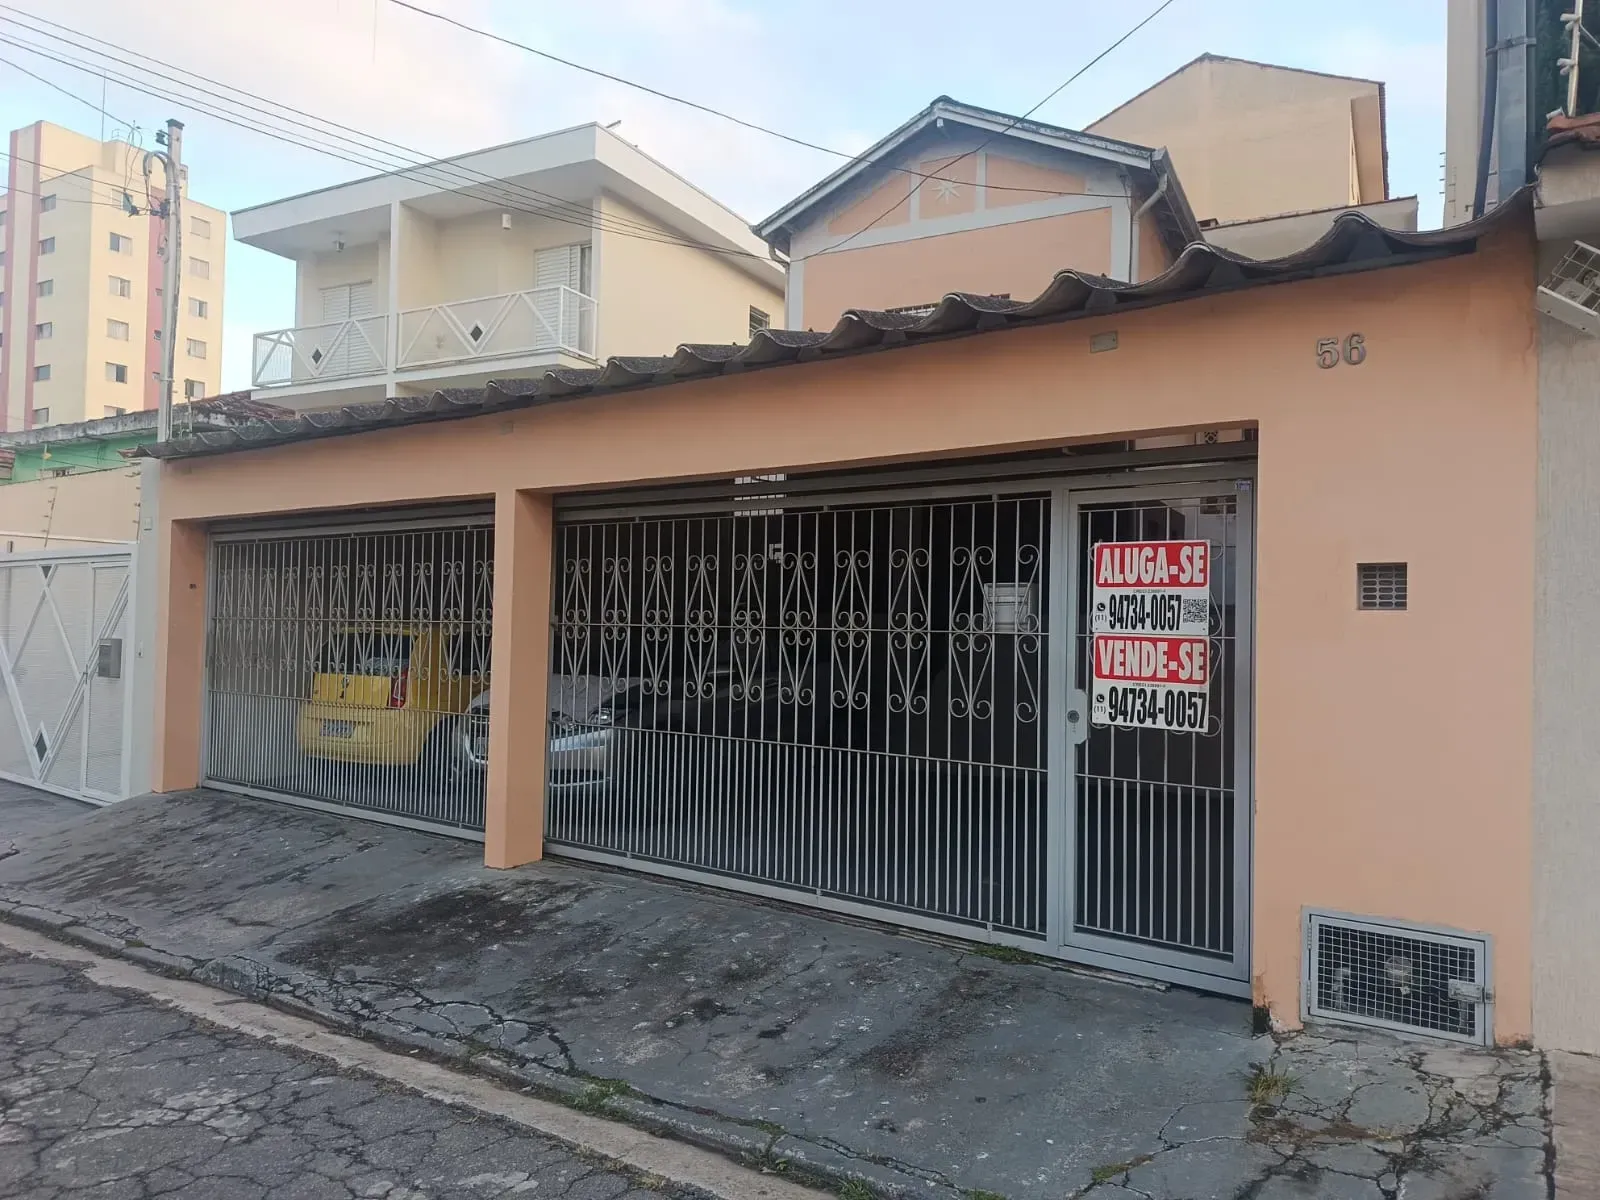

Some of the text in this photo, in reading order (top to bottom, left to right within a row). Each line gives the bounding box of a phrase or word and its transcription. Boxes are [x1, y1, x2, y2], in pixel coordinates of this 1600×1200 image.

[1316, 332, 1366, 369] 56
[1098, 545, 1205, 585] ALUGA-SE
[1109, 594, 1182, 631] 94734-0057
[1098, 639, 1205, 680] VENDE-SE
[1108, 686, 1207, 729] 94734-0057
